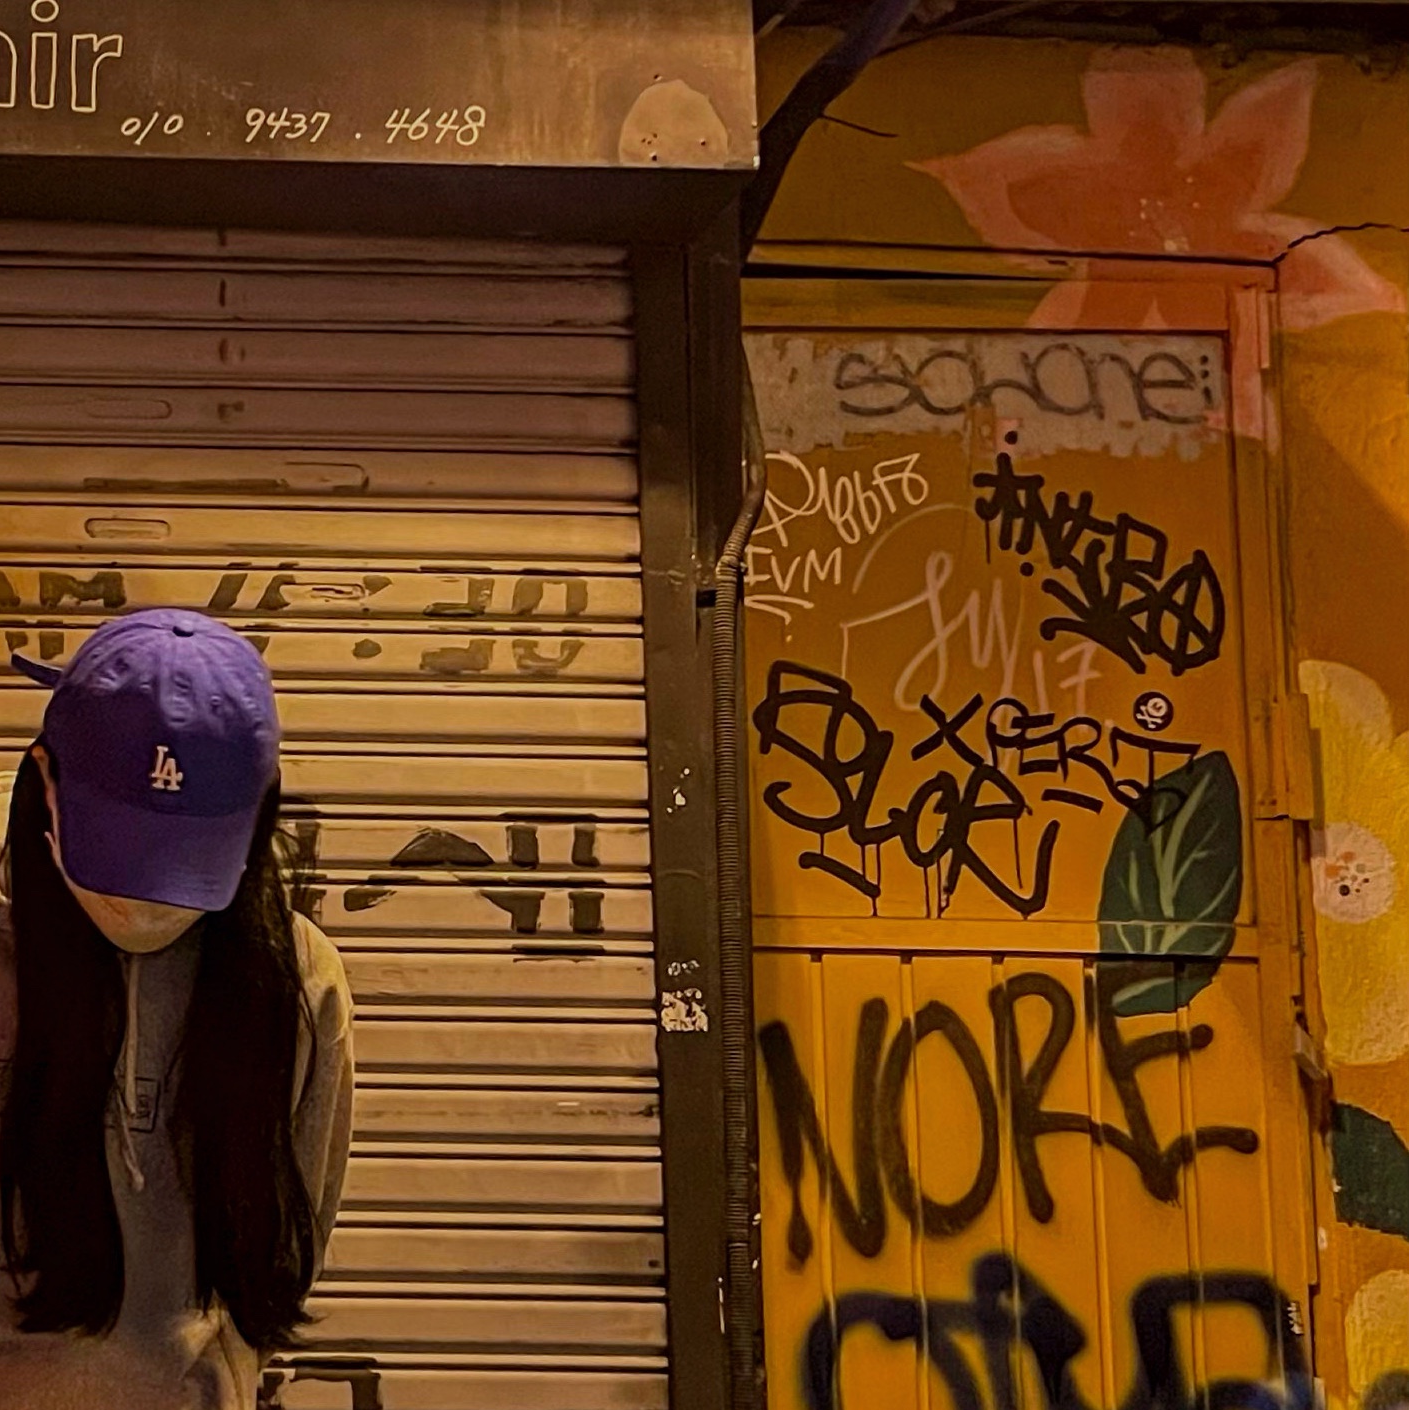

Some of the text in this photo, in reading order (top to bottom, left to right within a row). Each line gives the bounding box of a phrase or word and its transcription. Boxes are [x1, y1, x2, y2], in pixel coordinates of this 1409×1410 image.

[244, 107, 331, 143] 9437
[384, 105, 486, 146] 4648
[149, 745, 184, 791] LA
